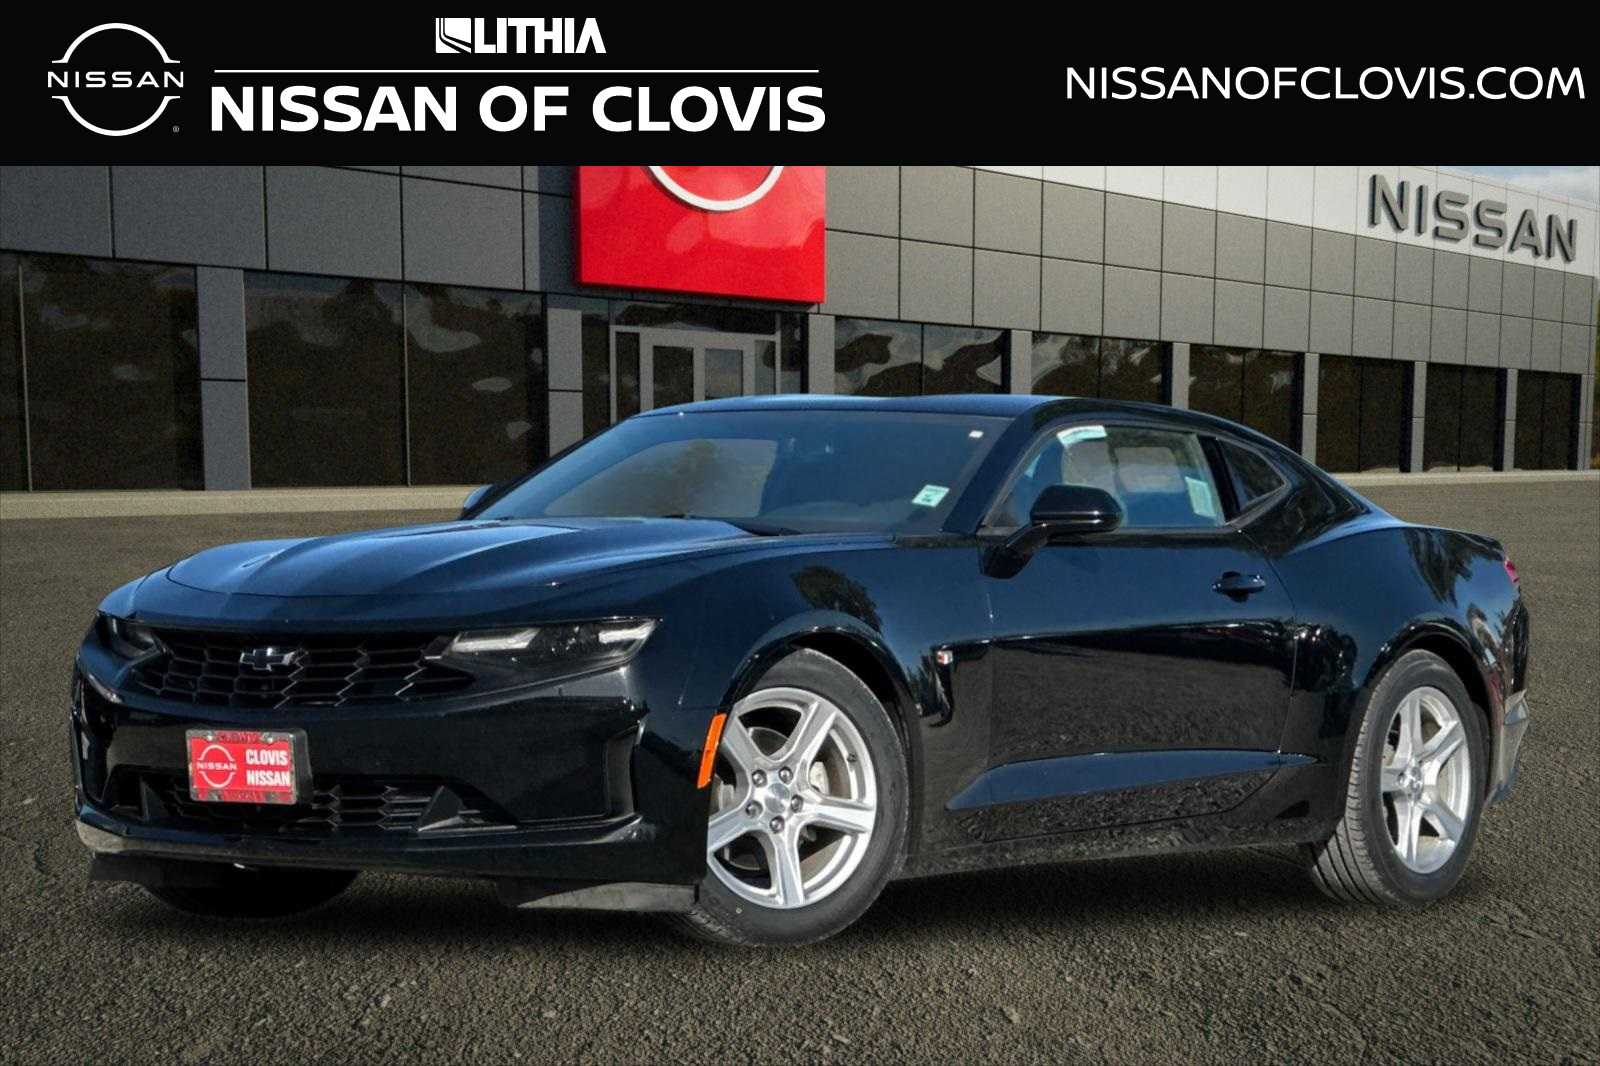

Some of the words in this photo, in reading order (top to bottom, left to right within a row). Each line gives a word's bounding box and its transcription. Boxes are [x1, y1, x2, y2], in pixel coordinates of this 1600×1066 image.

[1367, 174, 1578, 263] NISSAN
[245, 749, 289, 766] CLOVIS
[196, 761, 238, 771] NISSAN
[246, 770, 291, 786] NISSAN
